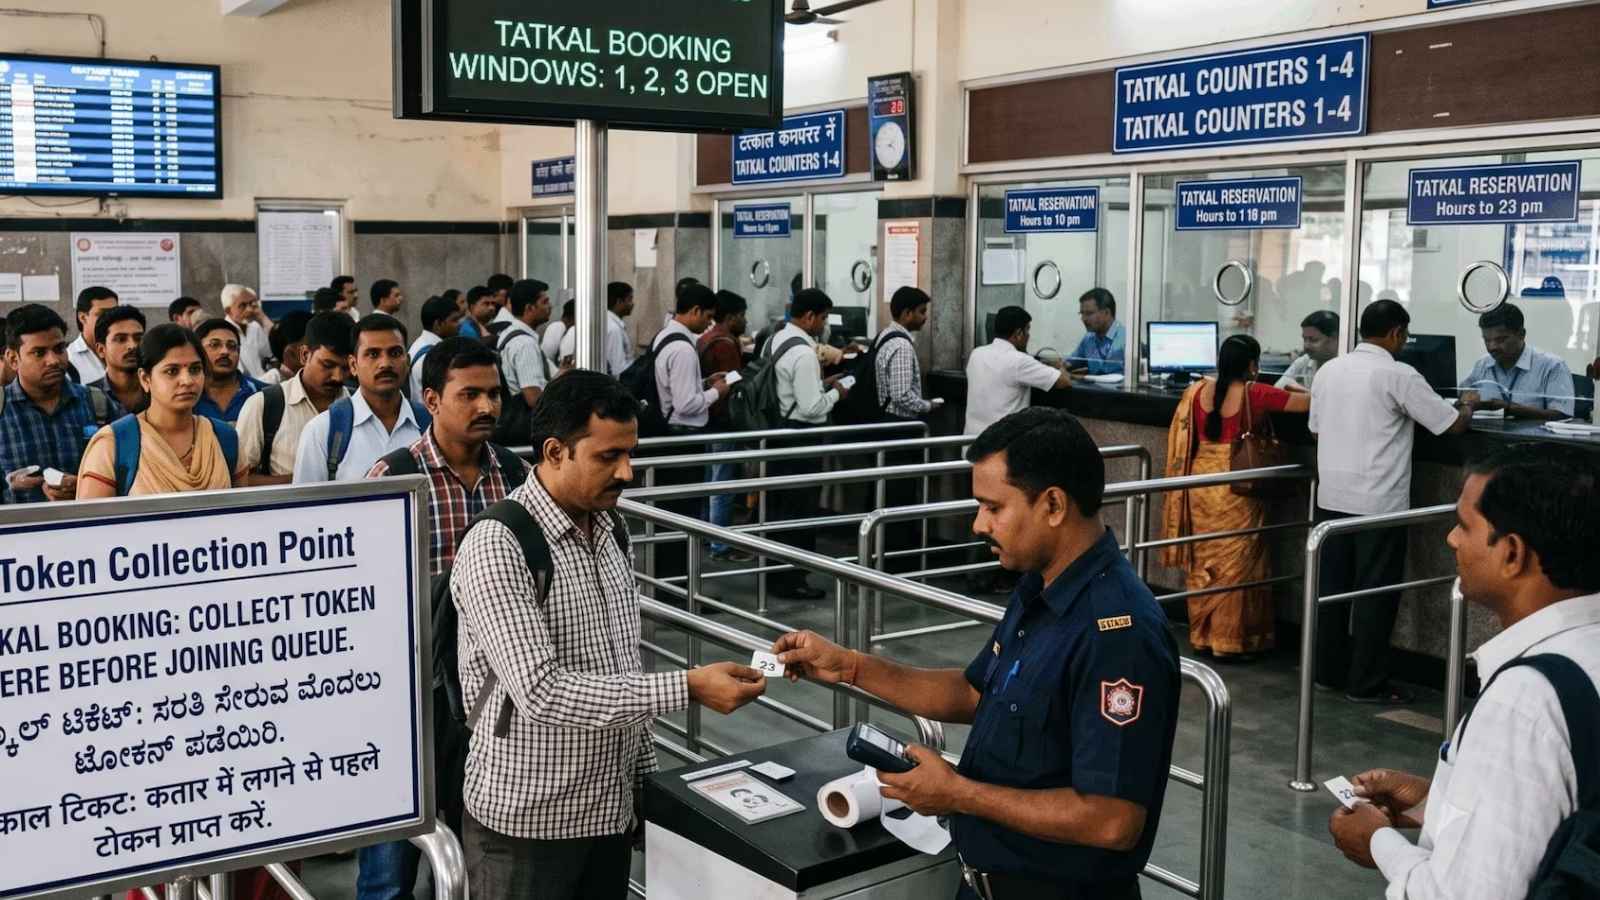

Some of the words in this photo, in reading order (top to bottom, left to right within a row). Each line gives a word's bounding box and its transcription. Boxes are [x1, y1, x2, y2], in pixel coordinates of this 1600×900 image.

[494, 20, 600, 53] TATKAL
[608, 30, 731, 63] BOOKING
[449, 52, 605, 88] WINDOWS:
[614, 67, 636, 95] 1,
[643, 67, 666, 96] 2,
[674, 69, 689, 94] 3
[697, 71, 768, 98] OPEN
[1123, 73, 1190, 104] TATKAL
[1196, 57, 1308, 96] COUNTERS
[1316, 51, 1354, 81] 1-4
[1123, 112, 1189, 141] TATKAL
[1195, 99, 1306, 135] COUNTERS
[1314, 95, 1352, 124] 1-4
[735, 158, 767, 176] TATKAL
[769, 152, 819, 173] COUNTERS
[823, 150, 840, 169] 1-4
[1415, 179, 1465, 197] TATKAL
[1469, 173, 1572, 195] RESERVATION
[1008, 197, 1037, 212] TATKAL
[1038, 195, 1095, 211] RESERVATION
[1181, 190, 1218, 206] TATKAL
[1221, 186, 1296, 205] RESERVATION
[1196, 209, 1224, 222] Hours
[1226, 209, 1236, 221] to
[1260, 210, 1277, 224] pm
[1436, 201, 1475, 216] Hours
[1480, 200, 1494, 215] to
[1498, 199, 1517, 215] 23
[1521, 201, 1543, 217] pm
[1020, 215, 1042, 226] Hours
[1043, 215, 1052, 225] to
[1055, 214, 1066, 225] 10
[1066, 215, 1080, 228] pm
[0, 555, 96, 594] Token
[109, 536, 267, 582] Collection
[279, 526, 355, 564] Point
[58, 609, 180, 649] BOOKING:
[189, 595, 294, 633] COLLECT
[302, 585, 376, 618] TOKEN
[0, 665, 50, 698] ERE
[59, 652, 158, 690] BEFORE
[165, 638, 263, 677] JOINING
[271, 627, 355, 662] QUEUE.
[759, 660, 776, 671] 23
[152, 691, 204, 725] ಸರತಿ
[215, 679, 289, 715] ಸೇರುವ
[298, 668, 381, 701] ಮೊದಲು
[75, 735, 175, 775] ಟೋಕನ್
[185, 720, 285, 757] ಪಡೆಯಿರಿ.
[59, 792, 137, 825] टिकट:
[145, 777, 209, 809] कतार
[215, 766, 235, 796] में
[241, 756, 296, 793] लगने
[302, 752, 323, 782] से
[330, 742, 381, 777] पहले
[93, 826, 162, 858] टोकन
[170, 815, 222, 846] प्राप्त
[229, 800, 273, 833] करें.
